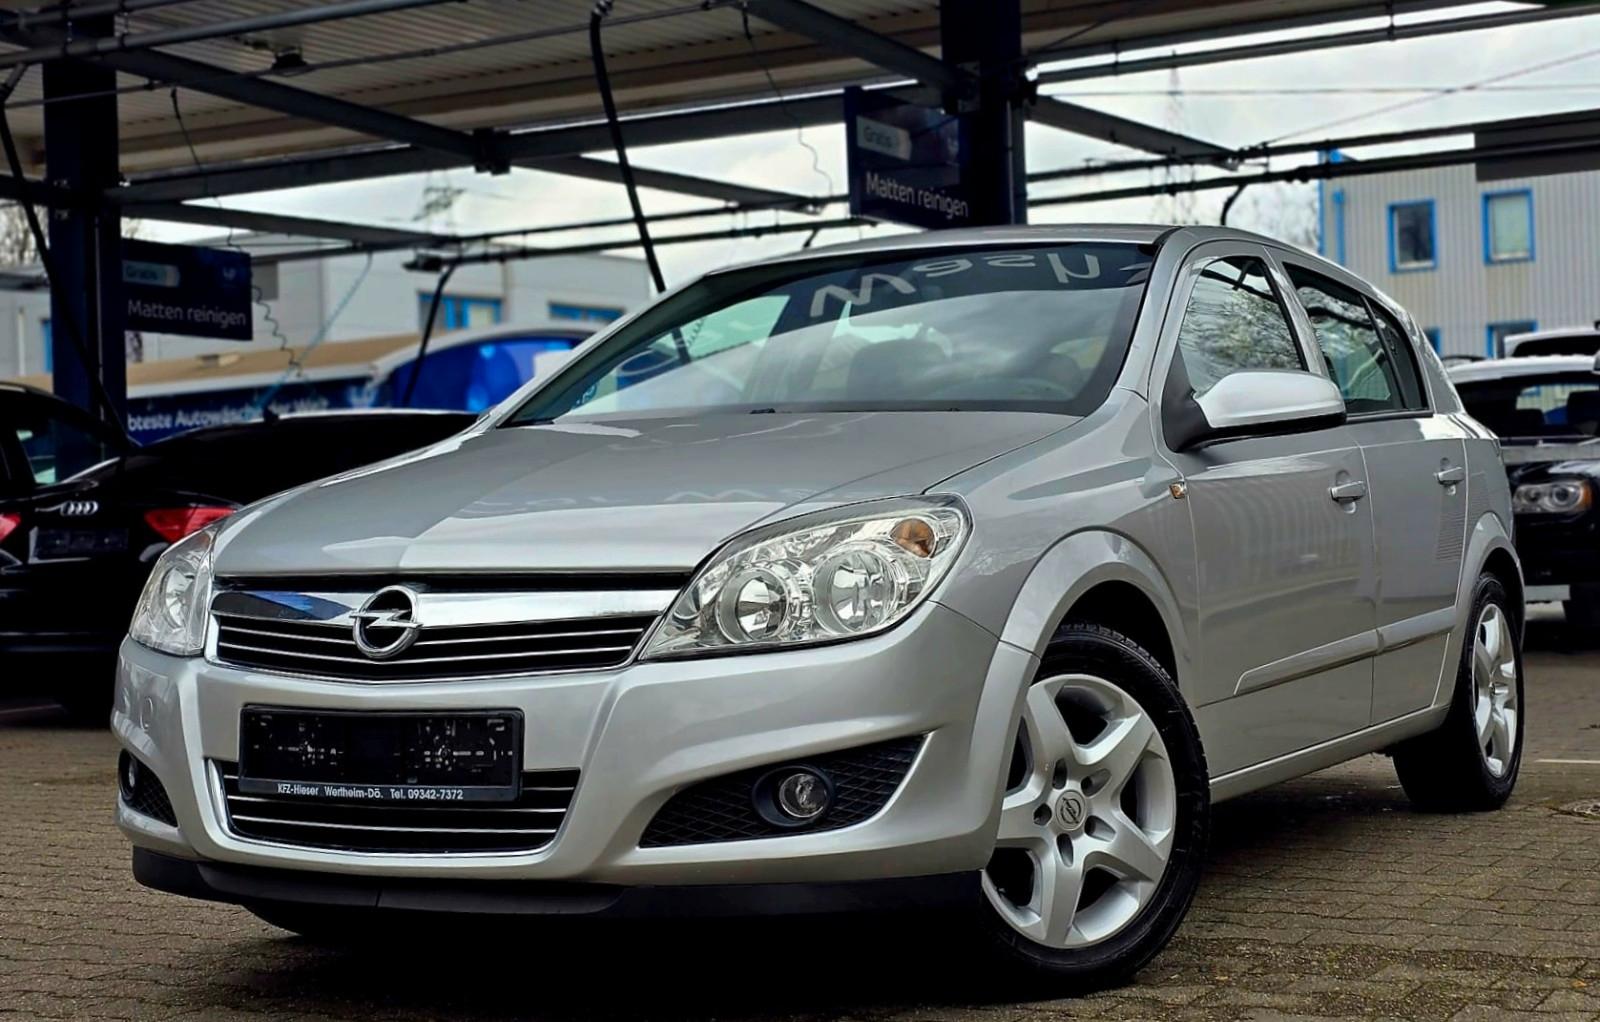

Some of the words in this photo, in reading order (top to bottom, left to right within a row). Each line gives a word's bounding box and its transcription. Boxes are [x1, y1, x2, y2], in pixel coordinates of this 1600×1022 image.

[866, 171, 915, 204] Matten
[918, 187, 969, 219] reinigen
[127, 299, 183, 320] Matten
[186, 304, 247, 329] reinigen
[277, 783, 319, 796] KFZ-Hieser
[408, 788, 464, 800] 09342-7372
